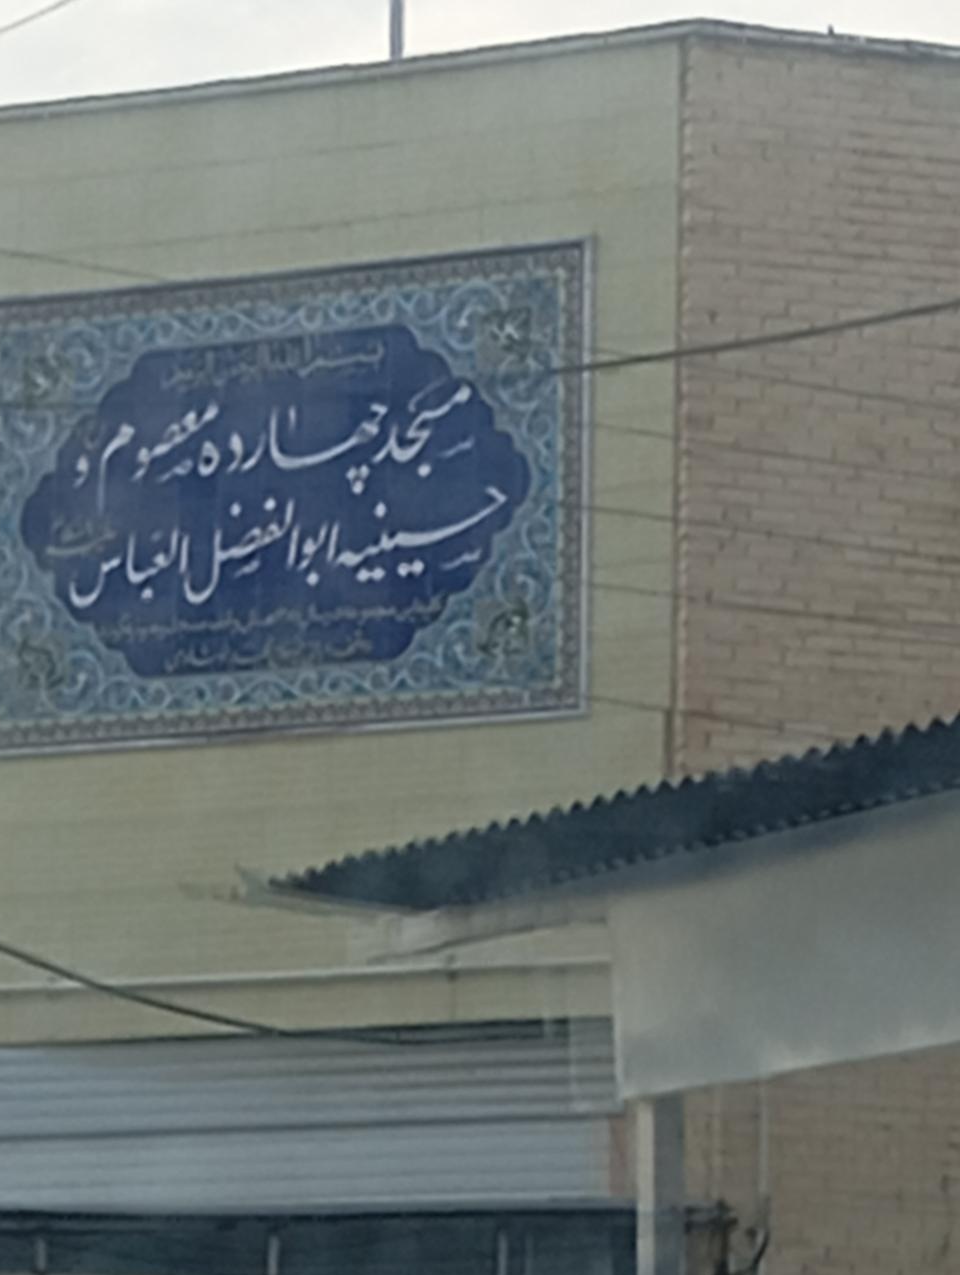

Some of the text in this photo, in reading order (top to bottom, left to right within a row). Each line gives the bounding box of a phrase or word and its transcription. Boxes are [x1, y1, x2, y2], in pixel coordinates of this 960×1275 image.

[96, 402, 220, 515] معصوم
[197, 402, 388, 494] چهارده
[372, 384, 472, 476] مسجد
[68, 526, 189, 608] العباس
[337, 486, 507, 582] حسینیه
